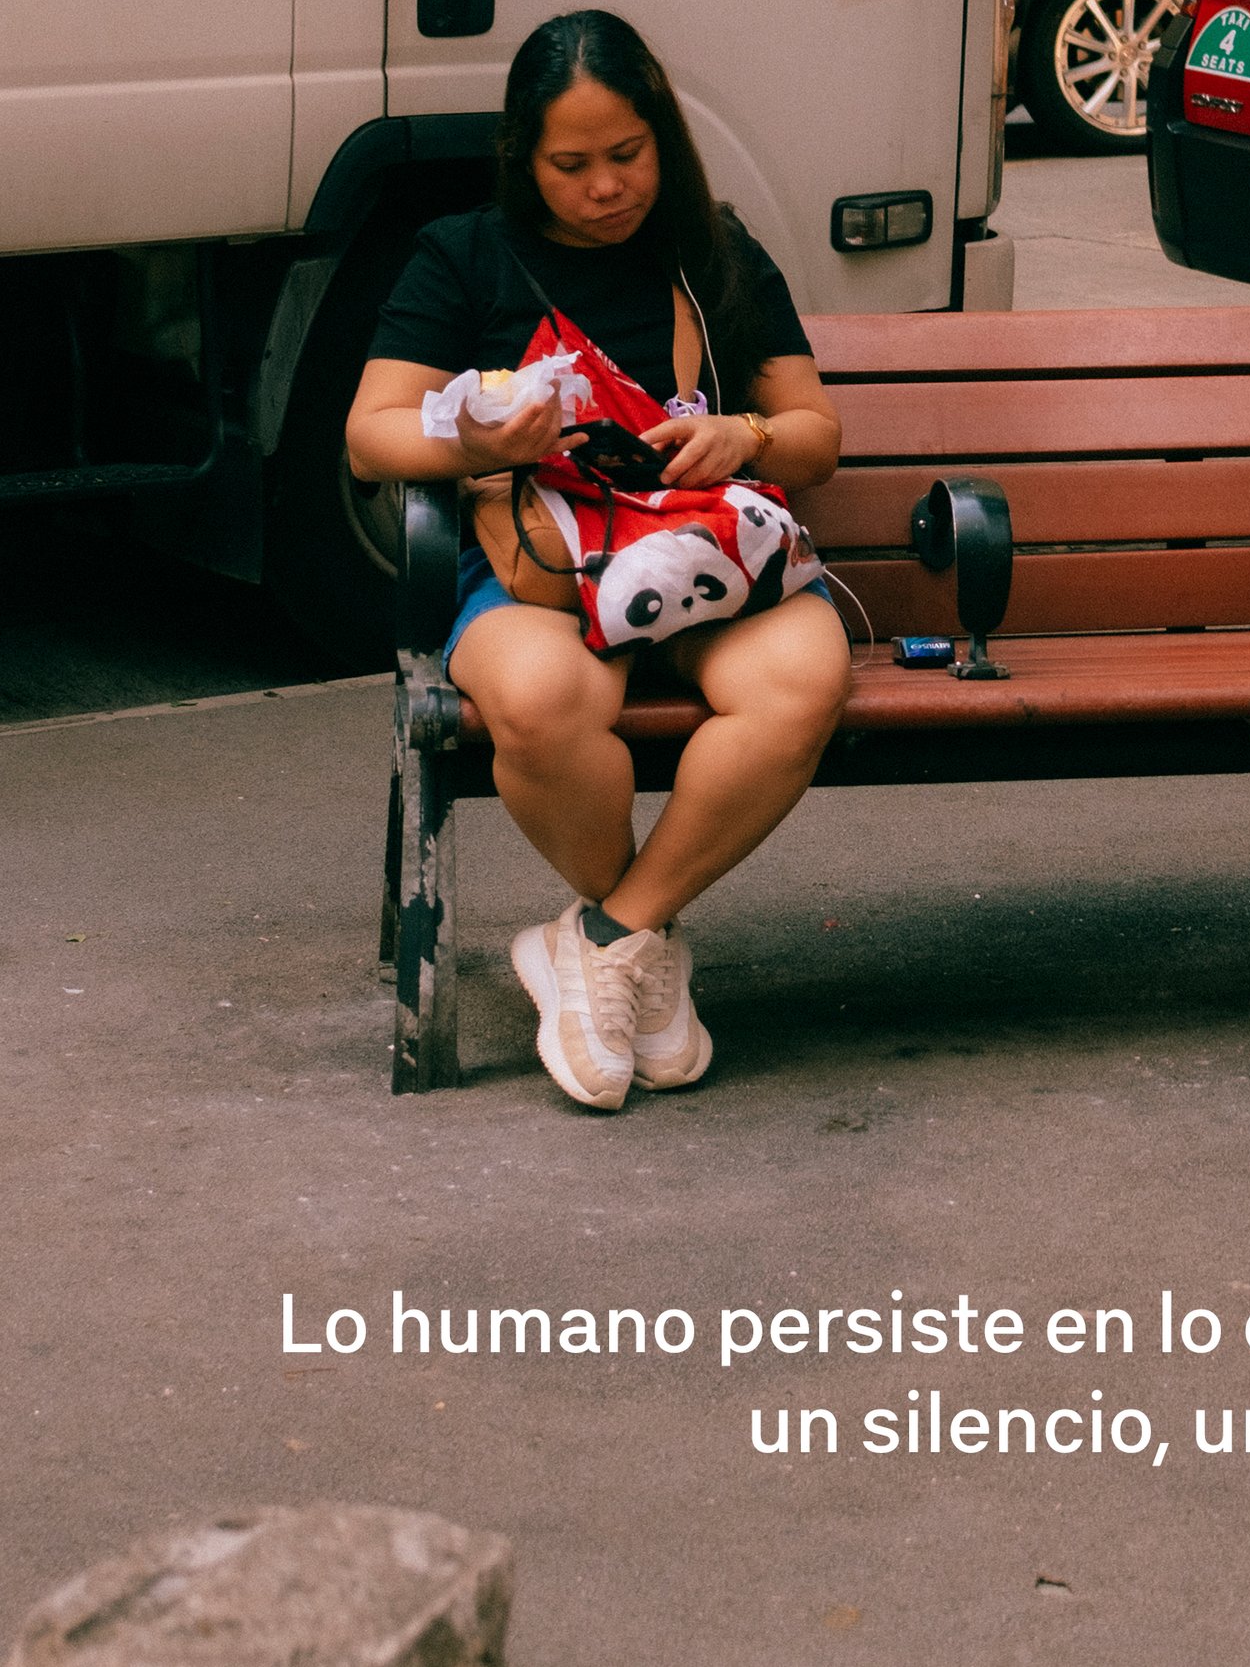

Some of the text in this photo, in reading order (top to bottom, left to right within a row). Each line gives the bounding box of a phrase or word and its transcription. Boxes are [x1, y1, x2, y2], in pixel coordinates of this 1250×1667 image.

[1220, 11, 1250, 31] TAXI
[1219, 29, 1236, 55] 4
[1201, 53, 1245, 74] SEATS
